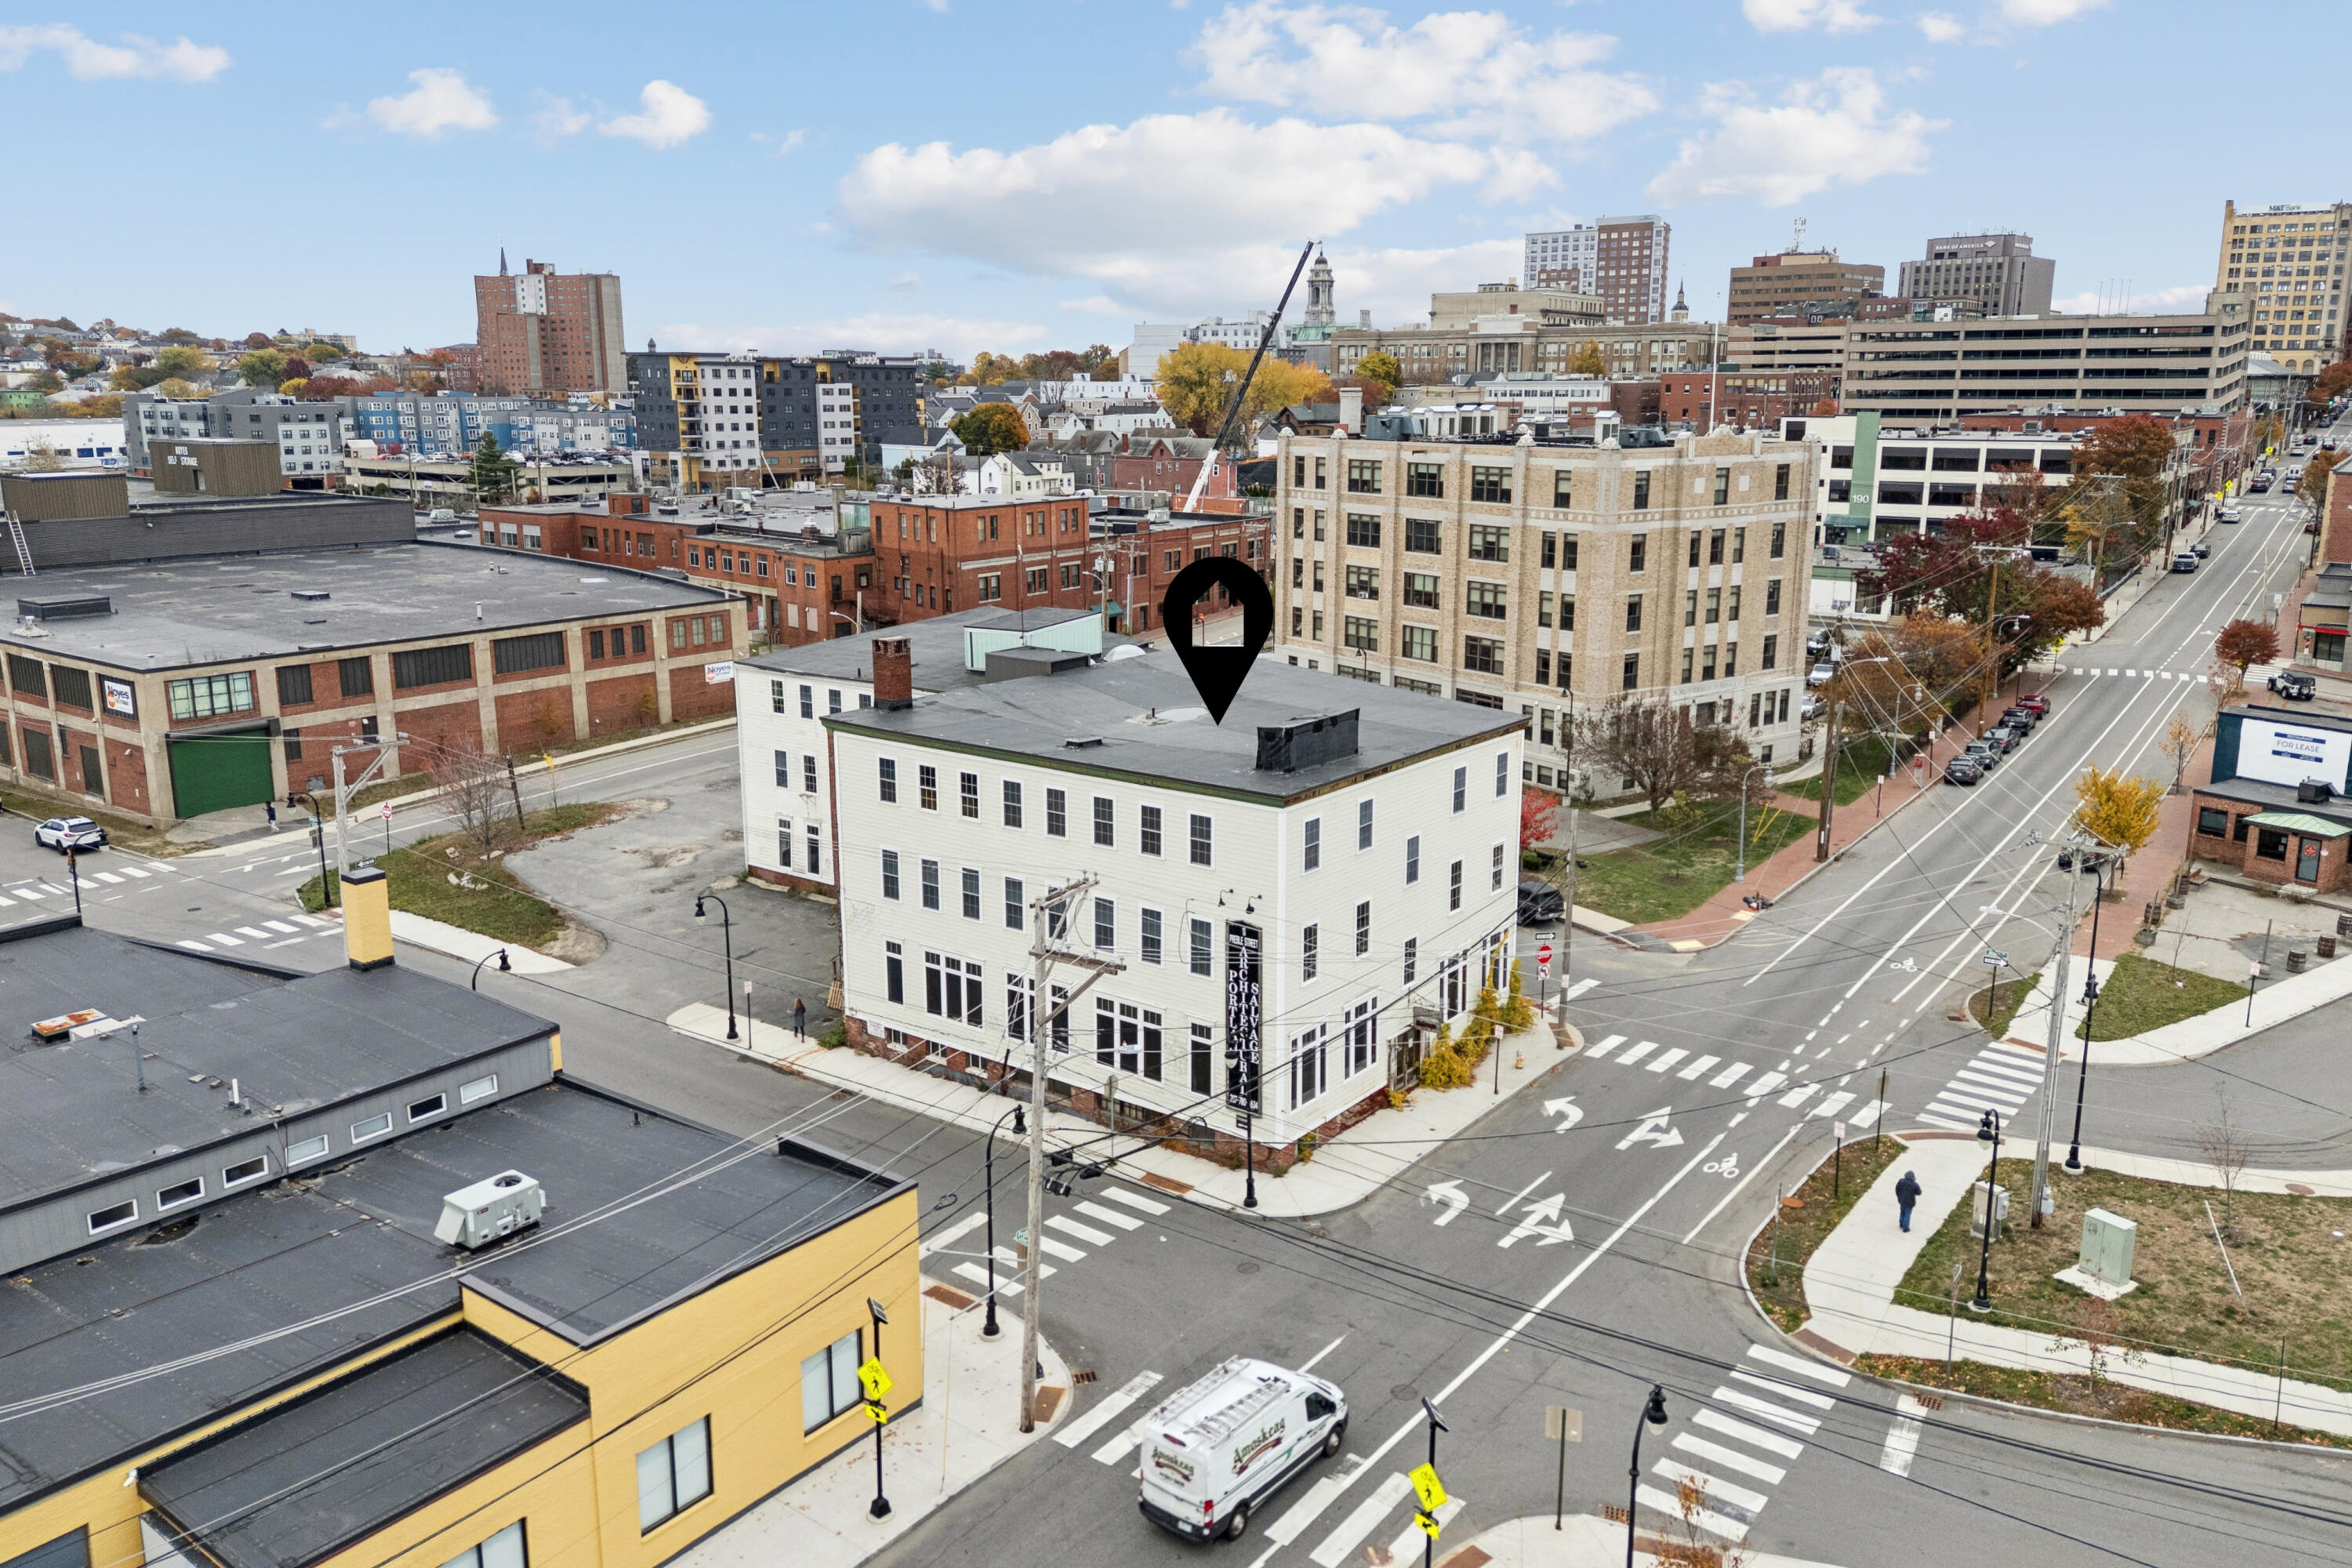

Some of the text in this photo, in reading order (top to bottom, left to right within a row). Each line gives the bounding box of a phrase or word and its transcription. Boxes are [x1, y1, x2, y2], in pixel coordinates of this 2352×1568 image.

[167, 456, 198, 466] SELF STORAGE
[1852, 494, 1870, 503] 190
[707, 664, 731, 673] Noyes
[107, 684, 130, 700] Noyes
[2277, 739, 2321, 753] FOR LEASE
[1229, 934, 1258, 949] PREBLE STREET
[1249, 982, 1259, 1065] SALVAGE
